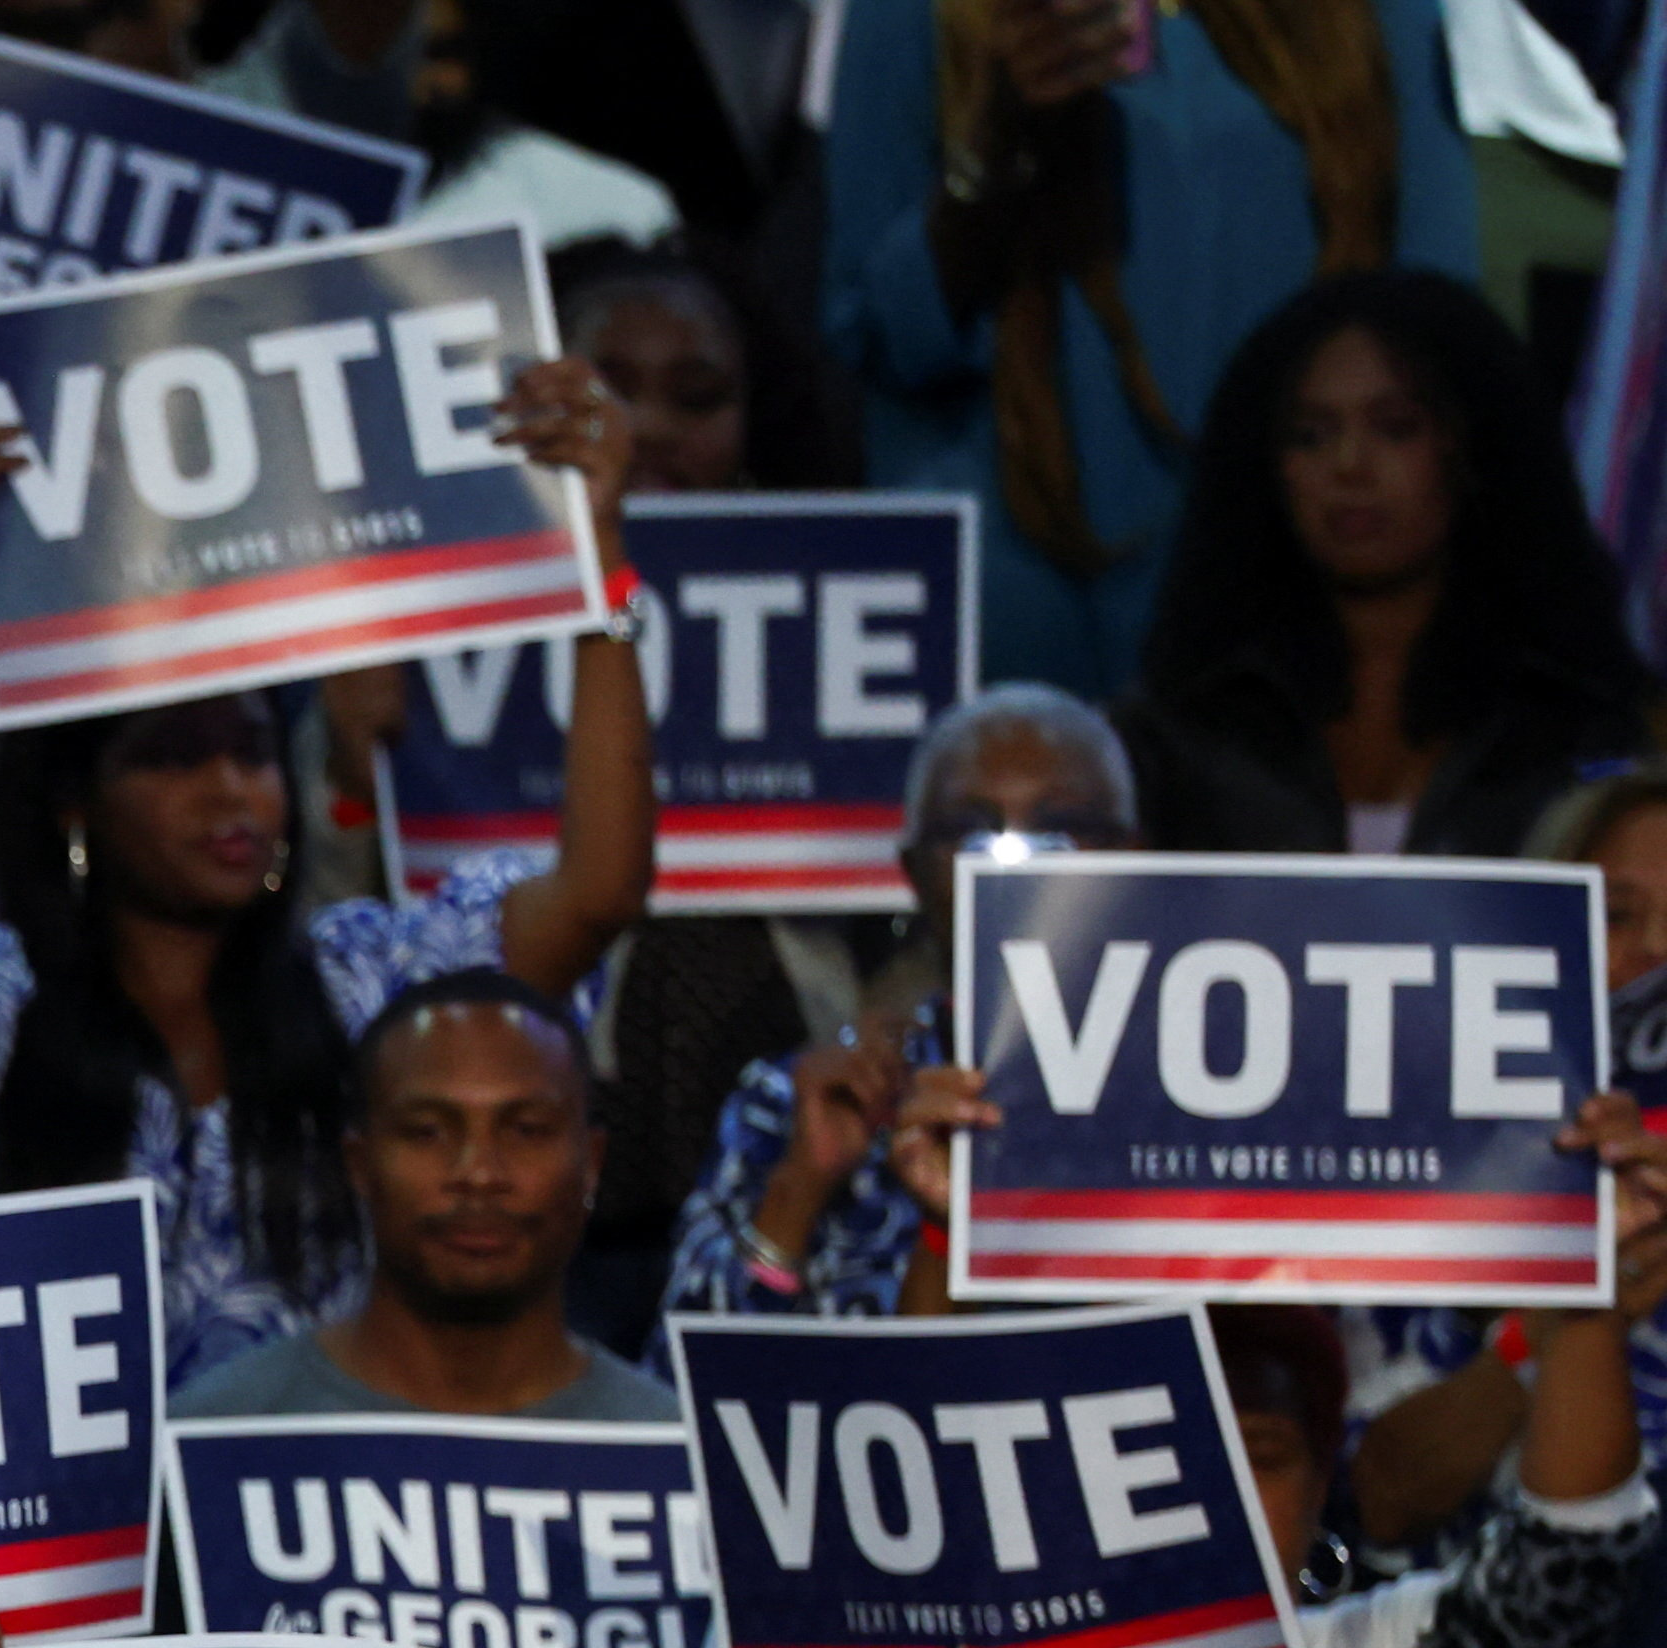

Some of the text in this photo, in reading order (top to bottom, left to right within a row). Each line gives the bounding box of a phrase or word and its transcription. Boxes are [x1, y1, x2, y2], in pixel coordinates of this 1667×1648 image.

[198, 536, 278, 573] VOTE
[289, 527, 323, 556] TO
[1000, 939, 1564, 1120] VOTE
[1129, 1144, 1443, 1184] TEXT VOTE TO 51015
[713, 1384, 1211, 1576] VOTE
[844, 1591, 1107, 1637] TEXT VOTE TO 51015
